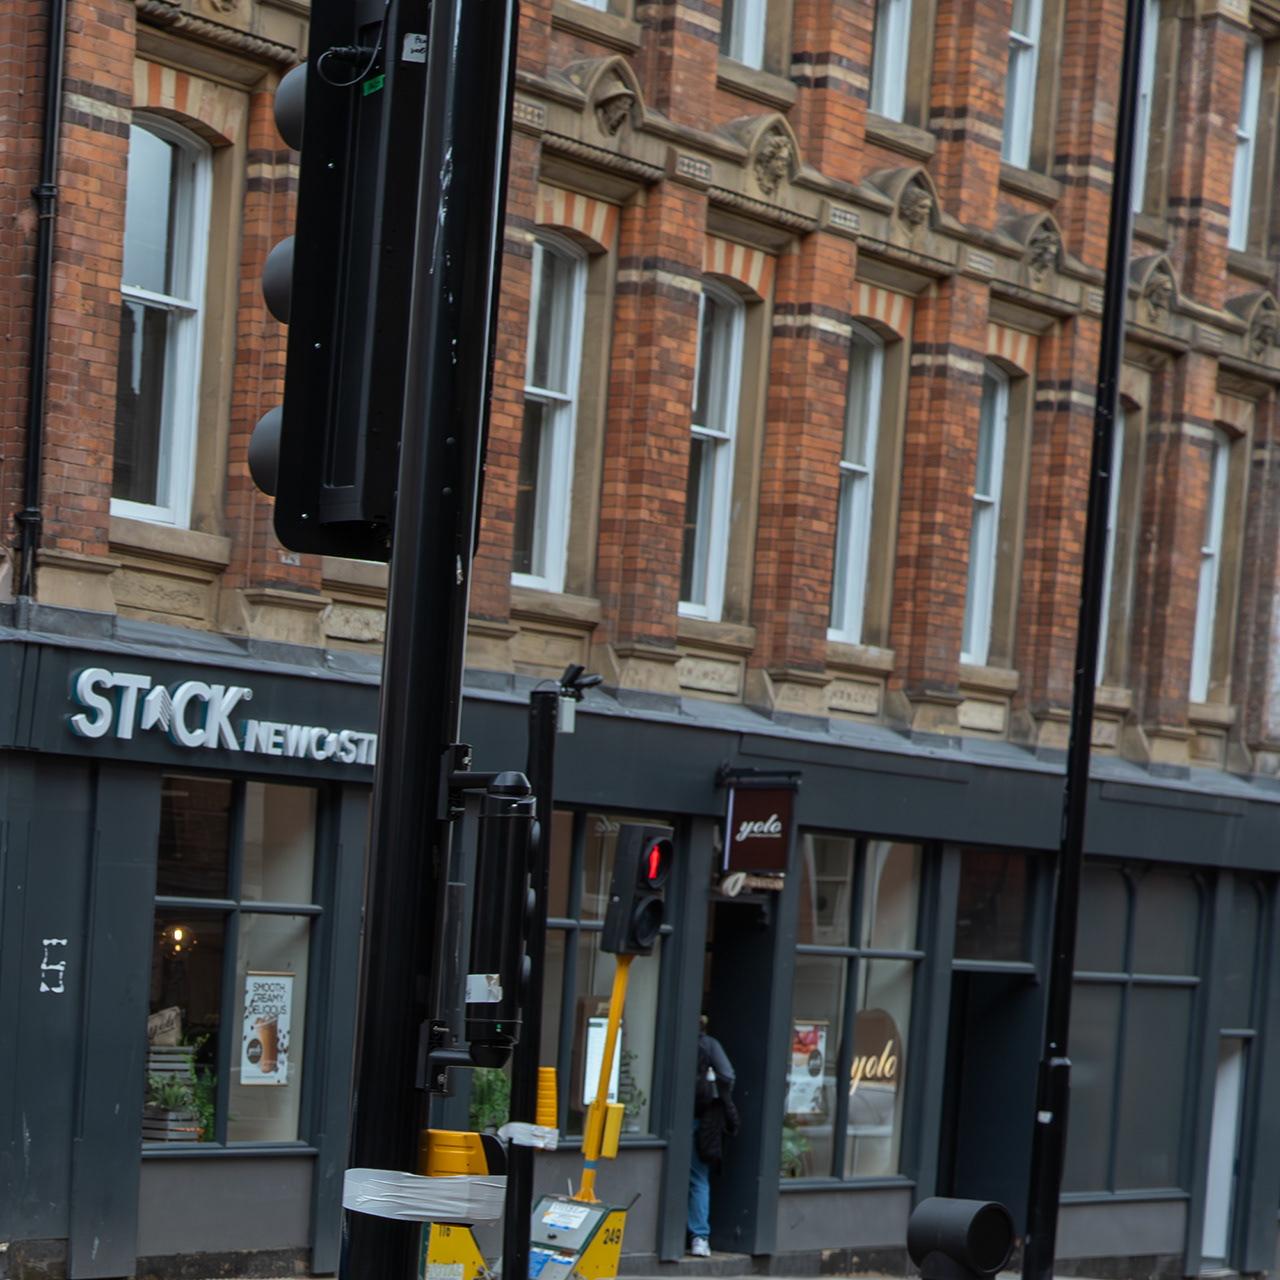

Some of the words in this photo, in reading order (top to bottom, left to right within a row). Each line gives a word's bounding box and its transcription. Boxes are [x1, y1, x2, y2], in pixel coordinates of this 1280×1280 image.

[71, 667, 242, 751] STACK
[244, 719, 377, 766] NEWCAST
[735, 813, 782, 842] yolo
[849, 1039, 898, 1096] yolo
[603, 1228, 622, 1245] 249
